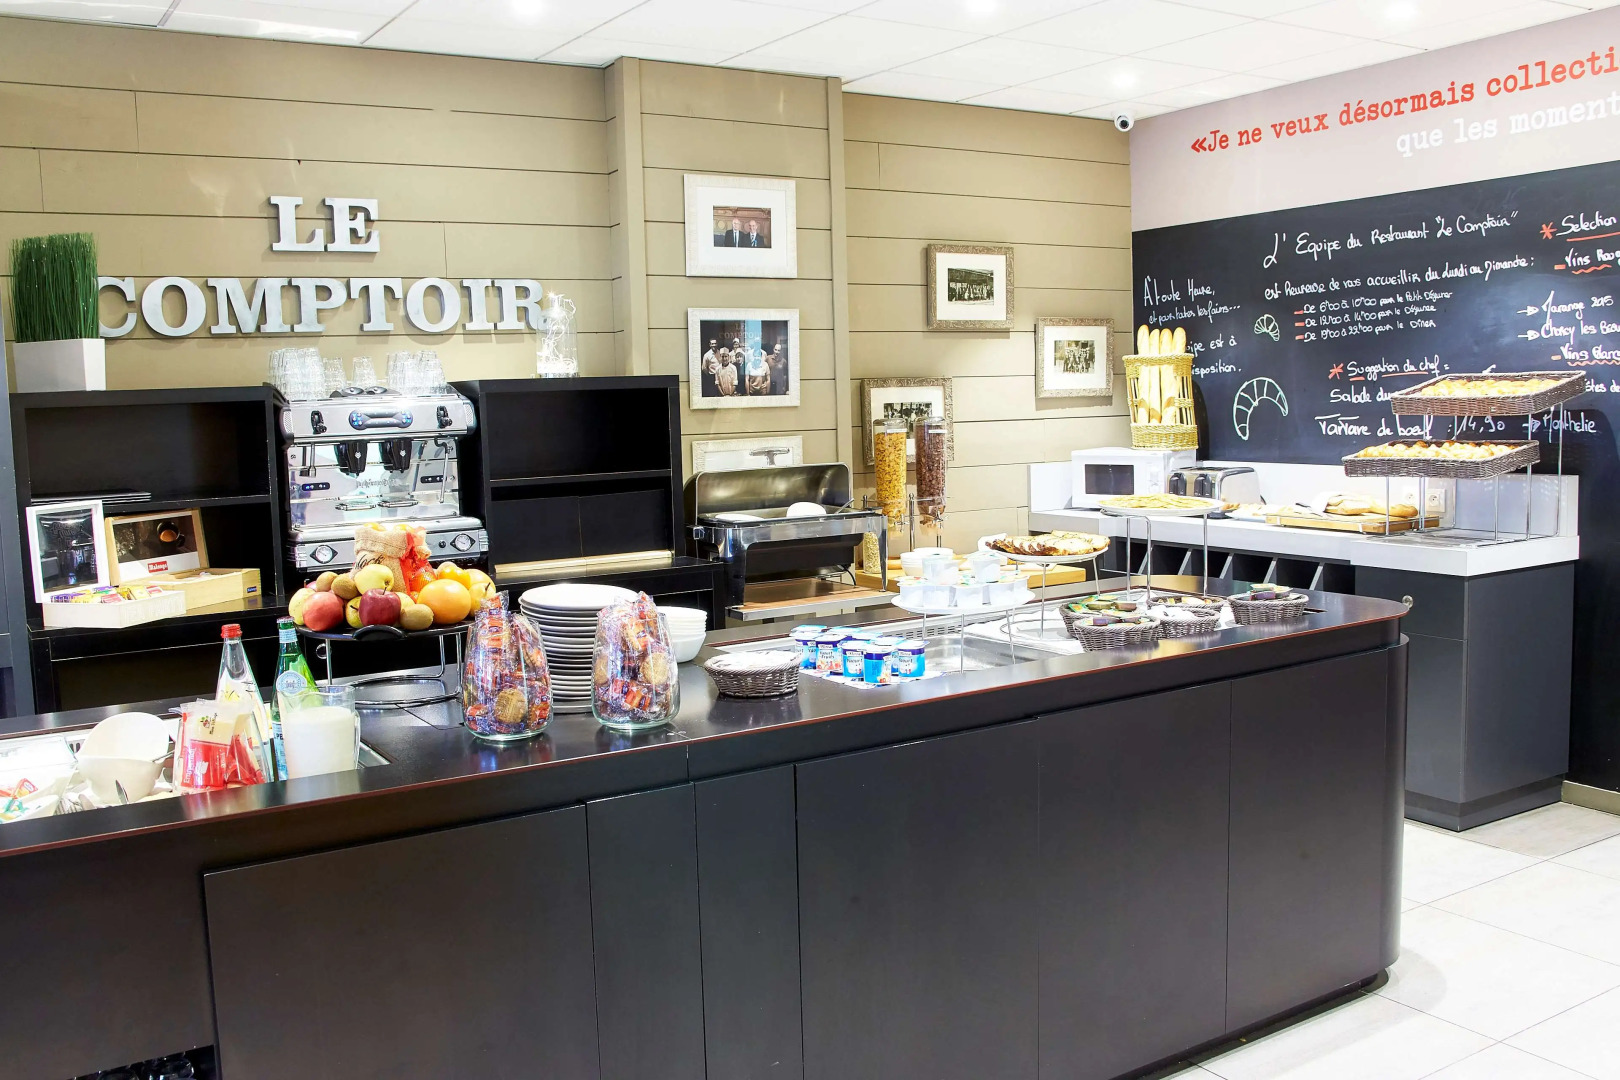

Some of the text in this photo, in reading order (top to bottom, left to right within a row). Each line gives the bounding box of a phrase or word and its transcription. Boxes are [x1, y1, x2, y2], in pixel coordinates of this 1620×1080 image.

[1190, 46, 1620, 153] «Je ne veux désormais collecti
[1396, 127, 1443, 158] que
[1453, 117, 1498, 144] les
[270, 195, 381, 253] LE
[1346, 232, 1363, 249] du
[1370, 222, 1430, 245] Restaurant
[1564, 247, 1591, 267] Vins
[1264, 282, 1281, 300] est
[1328, 277, 1341, 291] de
[1367, 269, 1421, 287] accueillir
[1425, 266, 1441, 281] du
[1469, 265, 1484, 275] au
[98, 276, 547, 338] COMPTOIR
[1303, 303, 1317, 314] De
[1320, 299, 1341, 313] 6h00
[1341, 299, 1350, 309] à
[1352, 296, 1377, 308] 10h00
[1396, 293, 1404, 303] le
[1305, 317, 1318, 328] De
[1320, 314, 1342, 326] 12h00
[1343, 313, 1351, 323] à
[1394, 307, 1402, 316] le
[1580, 319, 1598, 335] les
[1210, 332, 1225, 350] est
[1229, 335, 1238, 347] à
[1303, 331, 1318, 343] De
[1341, 327, 1348, 337] à
[1348, 322, 1373, 336] 22h00
[1396, 320, 1405, 329] le
[1560, 342, 1590, 360] Vins
[1346, 356, 1401, 382] Suggestion
[1403, 358, 1418, 372] du
[1419, 353, 1441, 378] chef
[1329, 384, 1373, 404] Salade
[1314, 413, 1372, 437] Tartare
[1377, 417, 1394, 438] de
